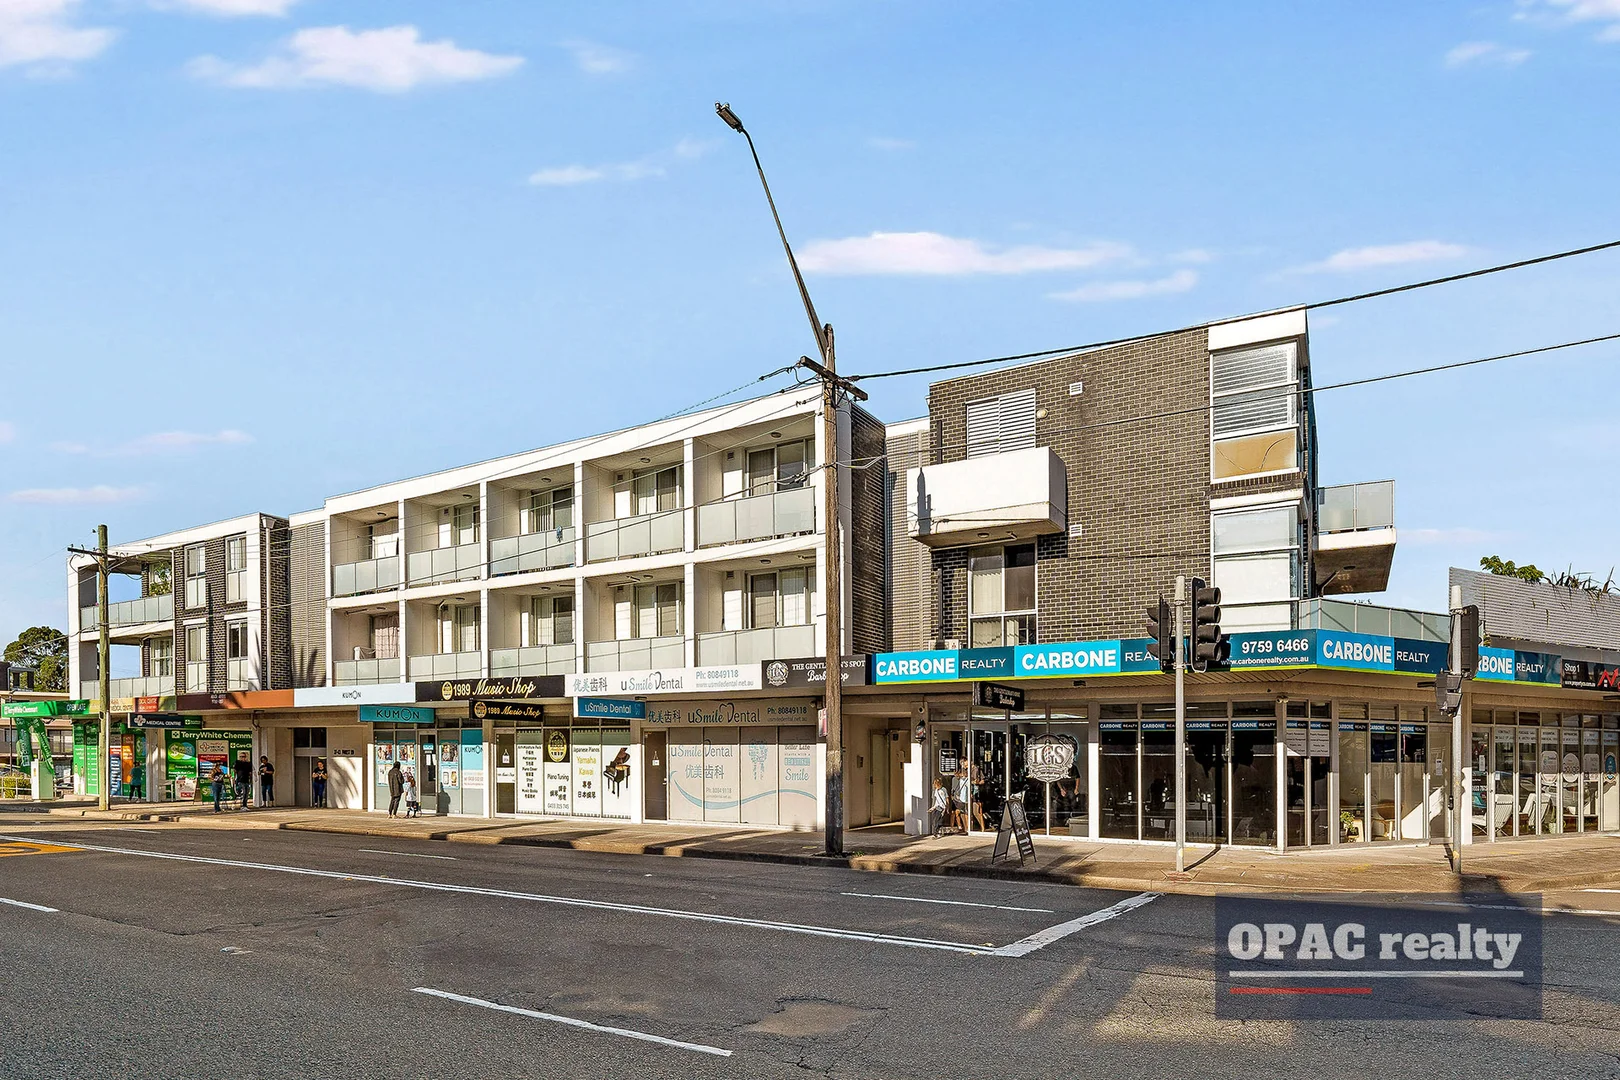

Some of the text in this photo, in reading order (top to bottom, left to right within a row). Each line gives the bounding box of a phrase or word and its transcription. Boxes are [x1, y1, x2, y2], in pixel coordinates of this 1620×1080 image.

[1242, 639, 1309, 655] 9759 6466
[1323, 639, 1430, 664] CARBONE REALTY
[792, 663, 805, 671] THE
[849, 660, 866, 668] SPOT
[1021, 649, 1177, 670] CARBONE REAY
[876, 657, 1006, 677] CARBONE REALTY
[1516, 662, 1544, 673] REALTY
[1564, 663, 1580, 674] Shop 1
[707, 669, 739, 679] 80849118
[653, 671, 684, 690] Dental
[453, 676, 537, 699] 1989 Music Shop
[342, 690, 362, 700] KUMON
[501, 706, 523, 716] Music
[523, 706, 542, 718] Shop
[585, 702, 632, 714] uSmile Dental
[724, 703, 761, 723] Dental
[778, 706, 808, 715] 80849118
[376, 708, 420, 721] KUMON
[181, 731, 223, 739] TerryWhite
[704, 739, 733, 757] Dental
[577, 756, 597, 764] Yamaha
[578, 767, 594, 775] Kawai
[785, 768, 810, 781] Smile
[558, 774, 569, 782] Tuning
